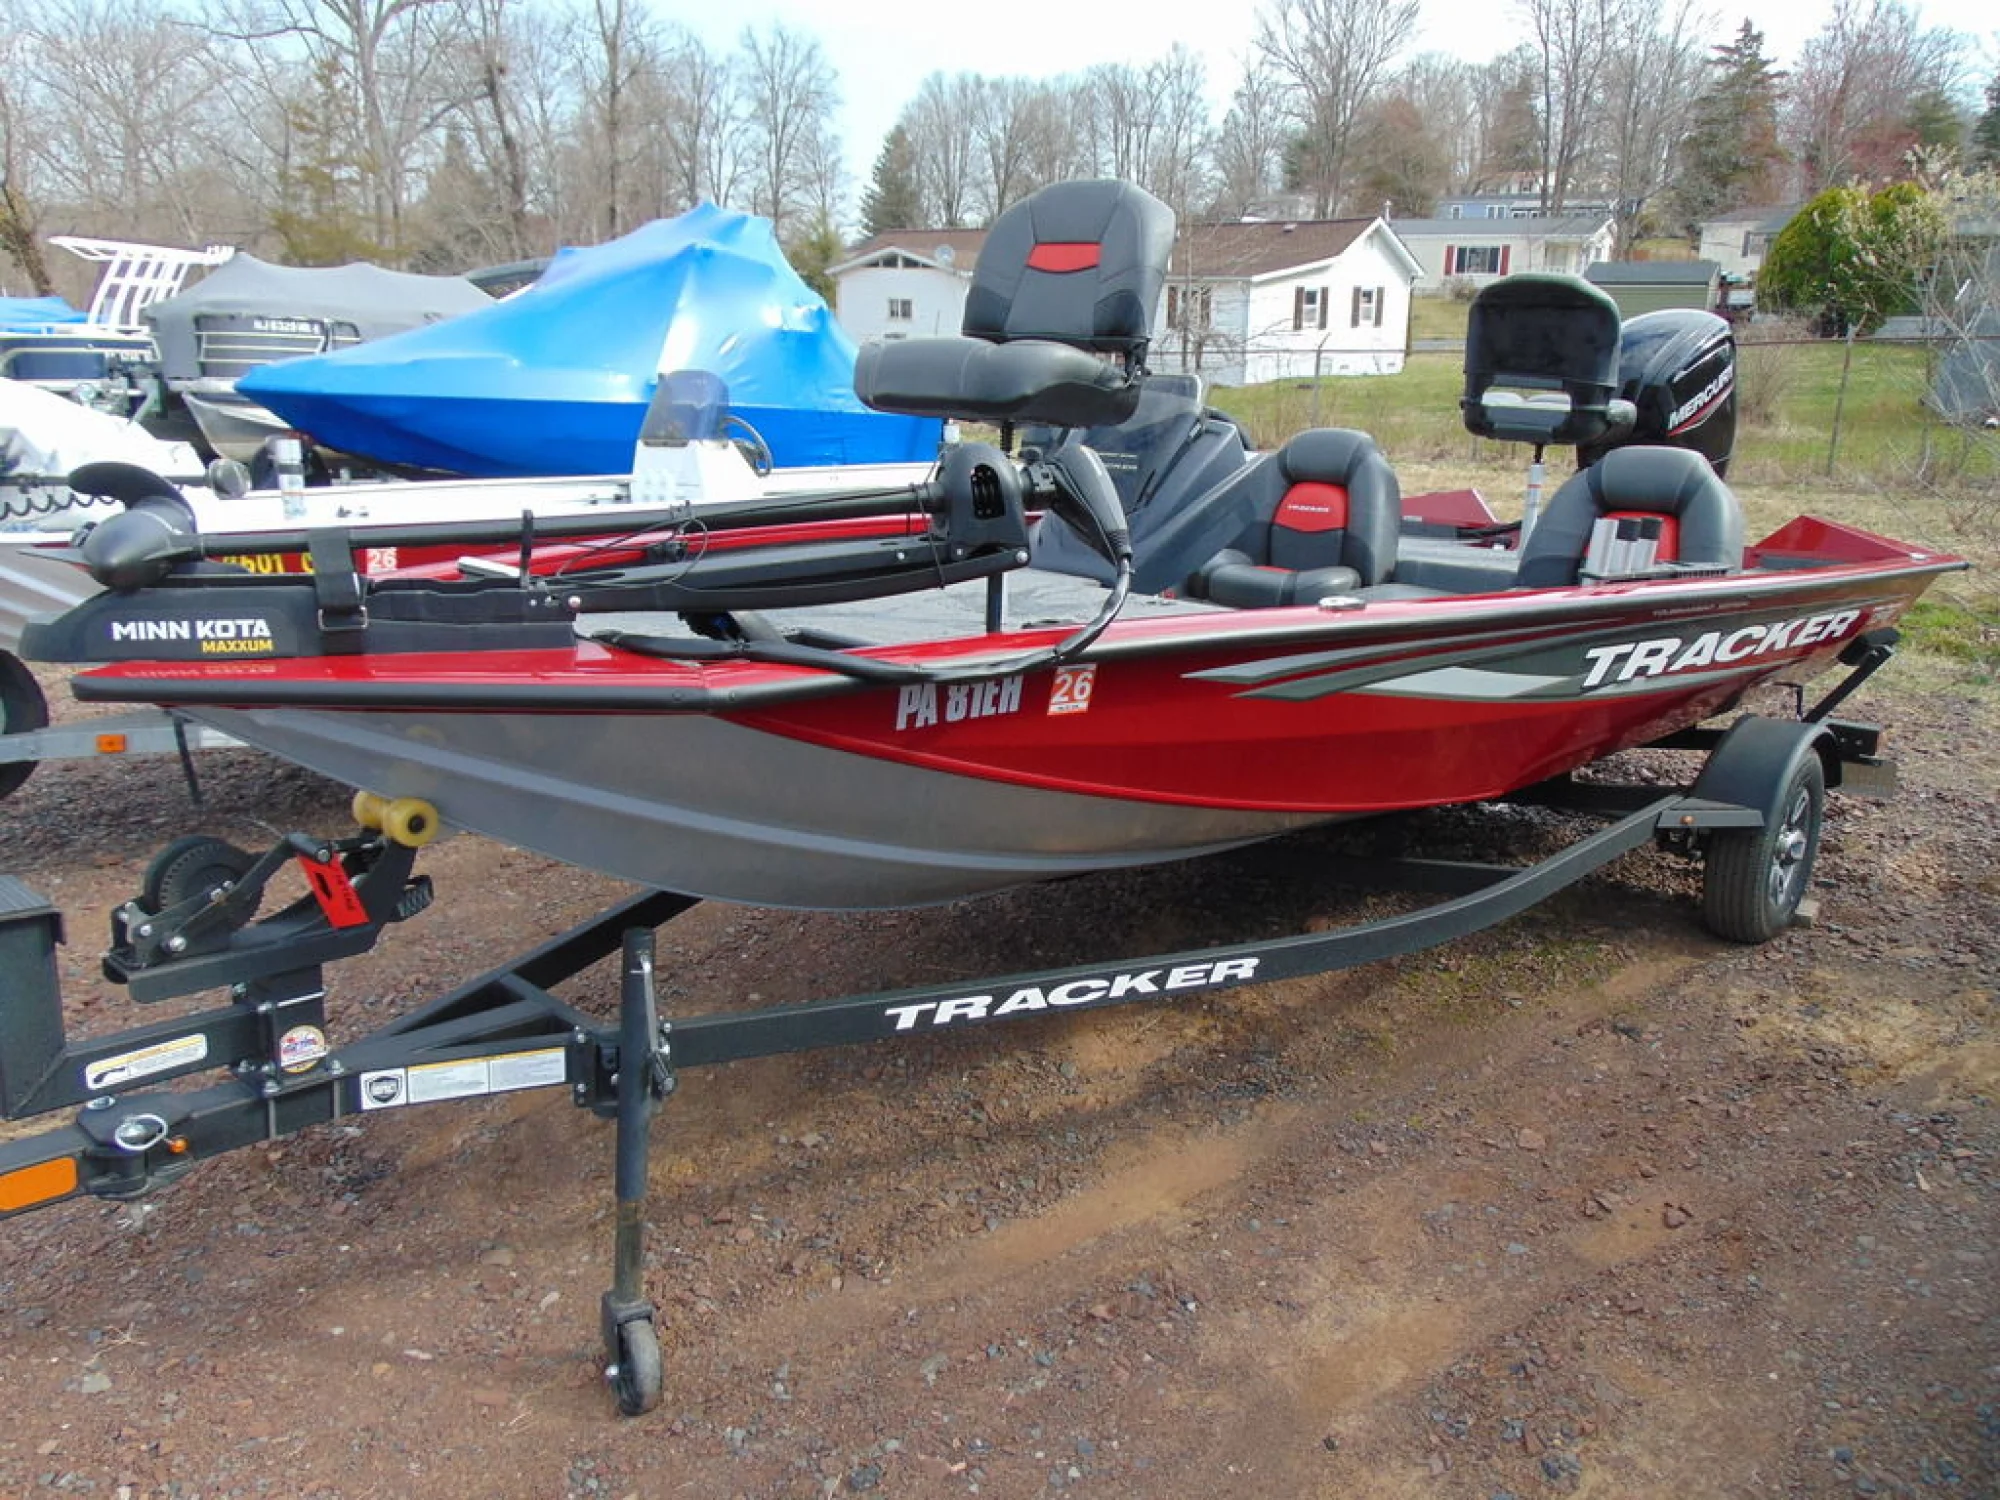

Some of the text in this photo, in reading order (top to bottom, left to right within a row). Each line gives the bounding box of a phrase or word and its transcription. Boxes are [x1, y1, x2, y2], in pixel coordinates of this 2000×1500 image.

[1668, 361, 1734, 430] MERCUR
[368, 549, 397, 572] 26
[111, 618, 273, 641] MINN KOTA
[202, 639, 274, 653] MAXXUM
[1583, 609, 1862, 687] TRACKER
[895, 681, 939, 731] PA
[1052, 671, 1093, 703] 26
[885, 957, 1261, 1030] TRACKER
